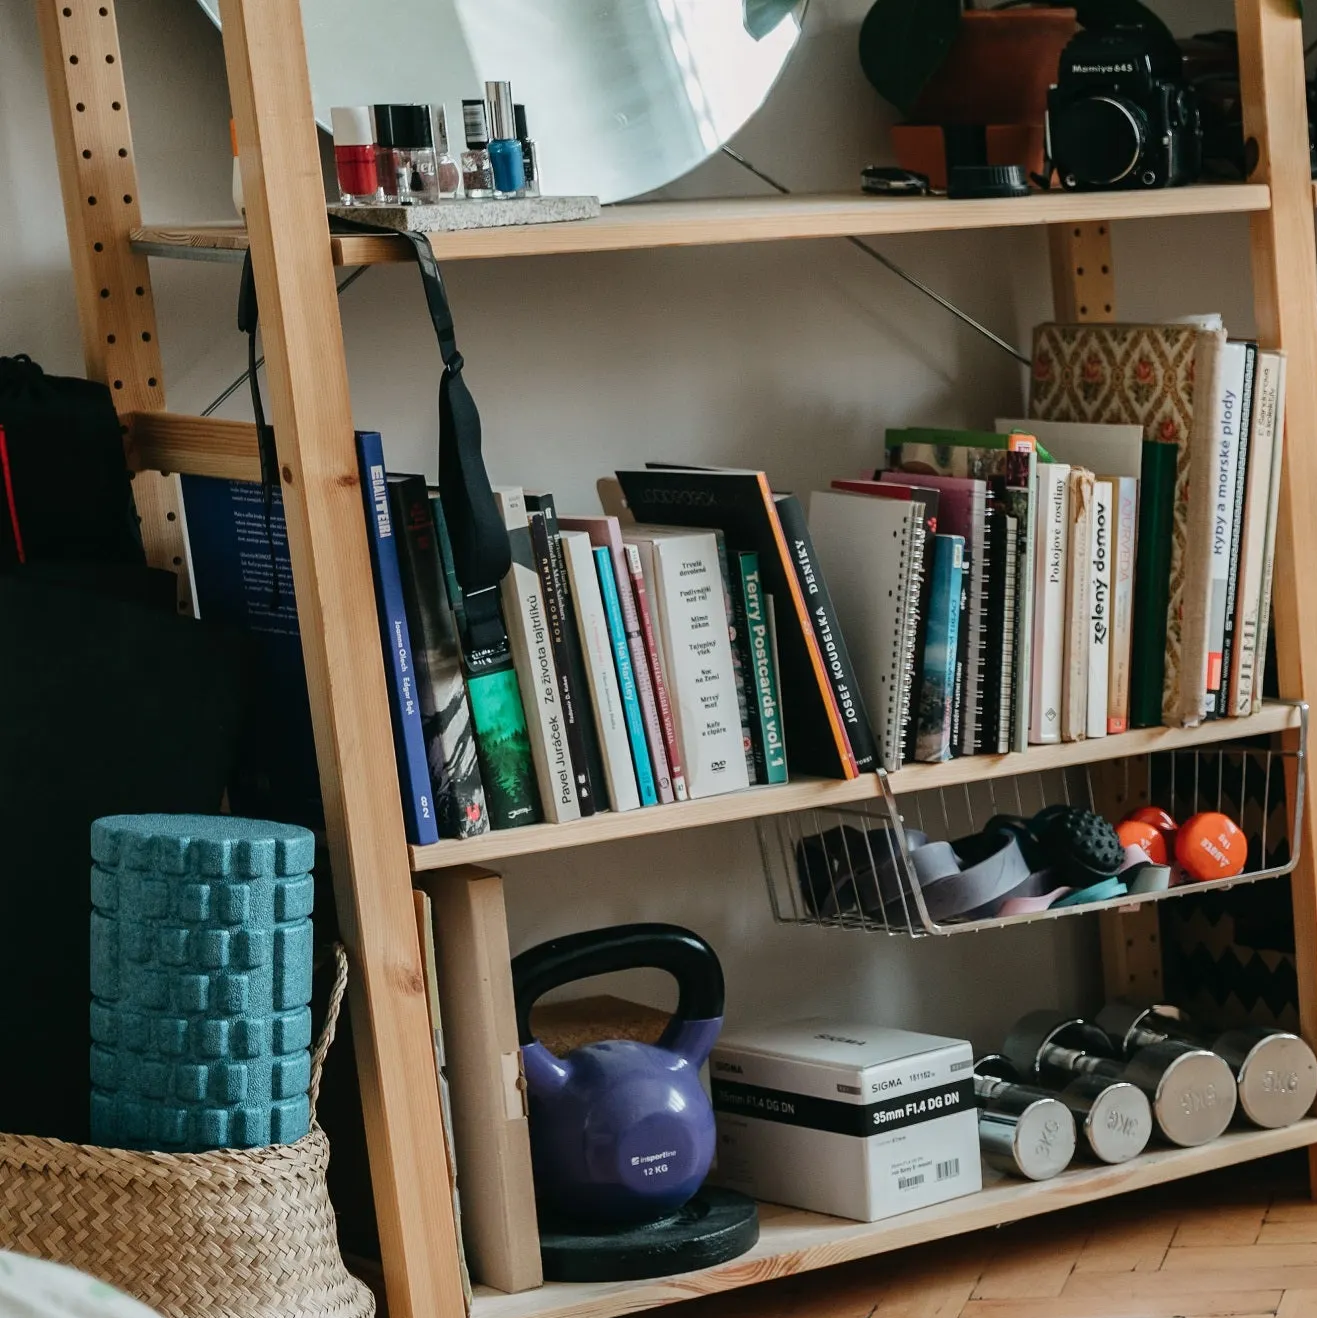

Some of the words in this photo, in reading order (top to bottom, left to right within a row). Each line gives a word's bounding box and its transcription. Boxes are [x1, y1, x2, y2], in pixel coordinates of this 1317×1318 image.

[1217, 503, 1226, 511] a
[1223, 390, 1236, 436] plody
[1054, 478, 1066, 523] rostliny
[1050, 528, 1063, 583] Pokojové
[1096, 502, 1108, 573] domov
[542, 559, 554, 593] FILMU
[795, 539, 819, 595] DENÍKY
[745, 571, 760, 621] Terry
[527, 595, 547, 645] tajtrlíků
[549, 599, 562, 643] ROZBOR
[399, 648, 407, 672] Olech
[817, 606, 844, 680] KOUDELKA
[538, 648, 552, 686] života
[618, 641, 626, 658] Hal
[622, 661, 634, 700] Hartley
[752, 625, 774, 717] Postcards
[403, 677, 411, 700] Edgar
[545, 688, 555, 704] Ze
[839, 684, 858, 723] JOSEF
[548, 716, 565, 767] Juráček
[766, 720, 781, 754] vol.
[562, 770, 573, 804] Pavel
[872, 1078, 902, 1093] SIGMA
[766, 1098, 779, 1111] DG
[781, 1102, 796, 1115] DN
[873, 1107, 905, 1125] 35mm
[905, 1100, 926, 1117] F1.4
[928, 1095, 943, 1111] DG
[944, 1091, 960, 1107] DN
[640, 1150, 677, 1164] insportline
[643, 1167, 654, 1176] 12
[655, 1164, 668, 1174] KG
